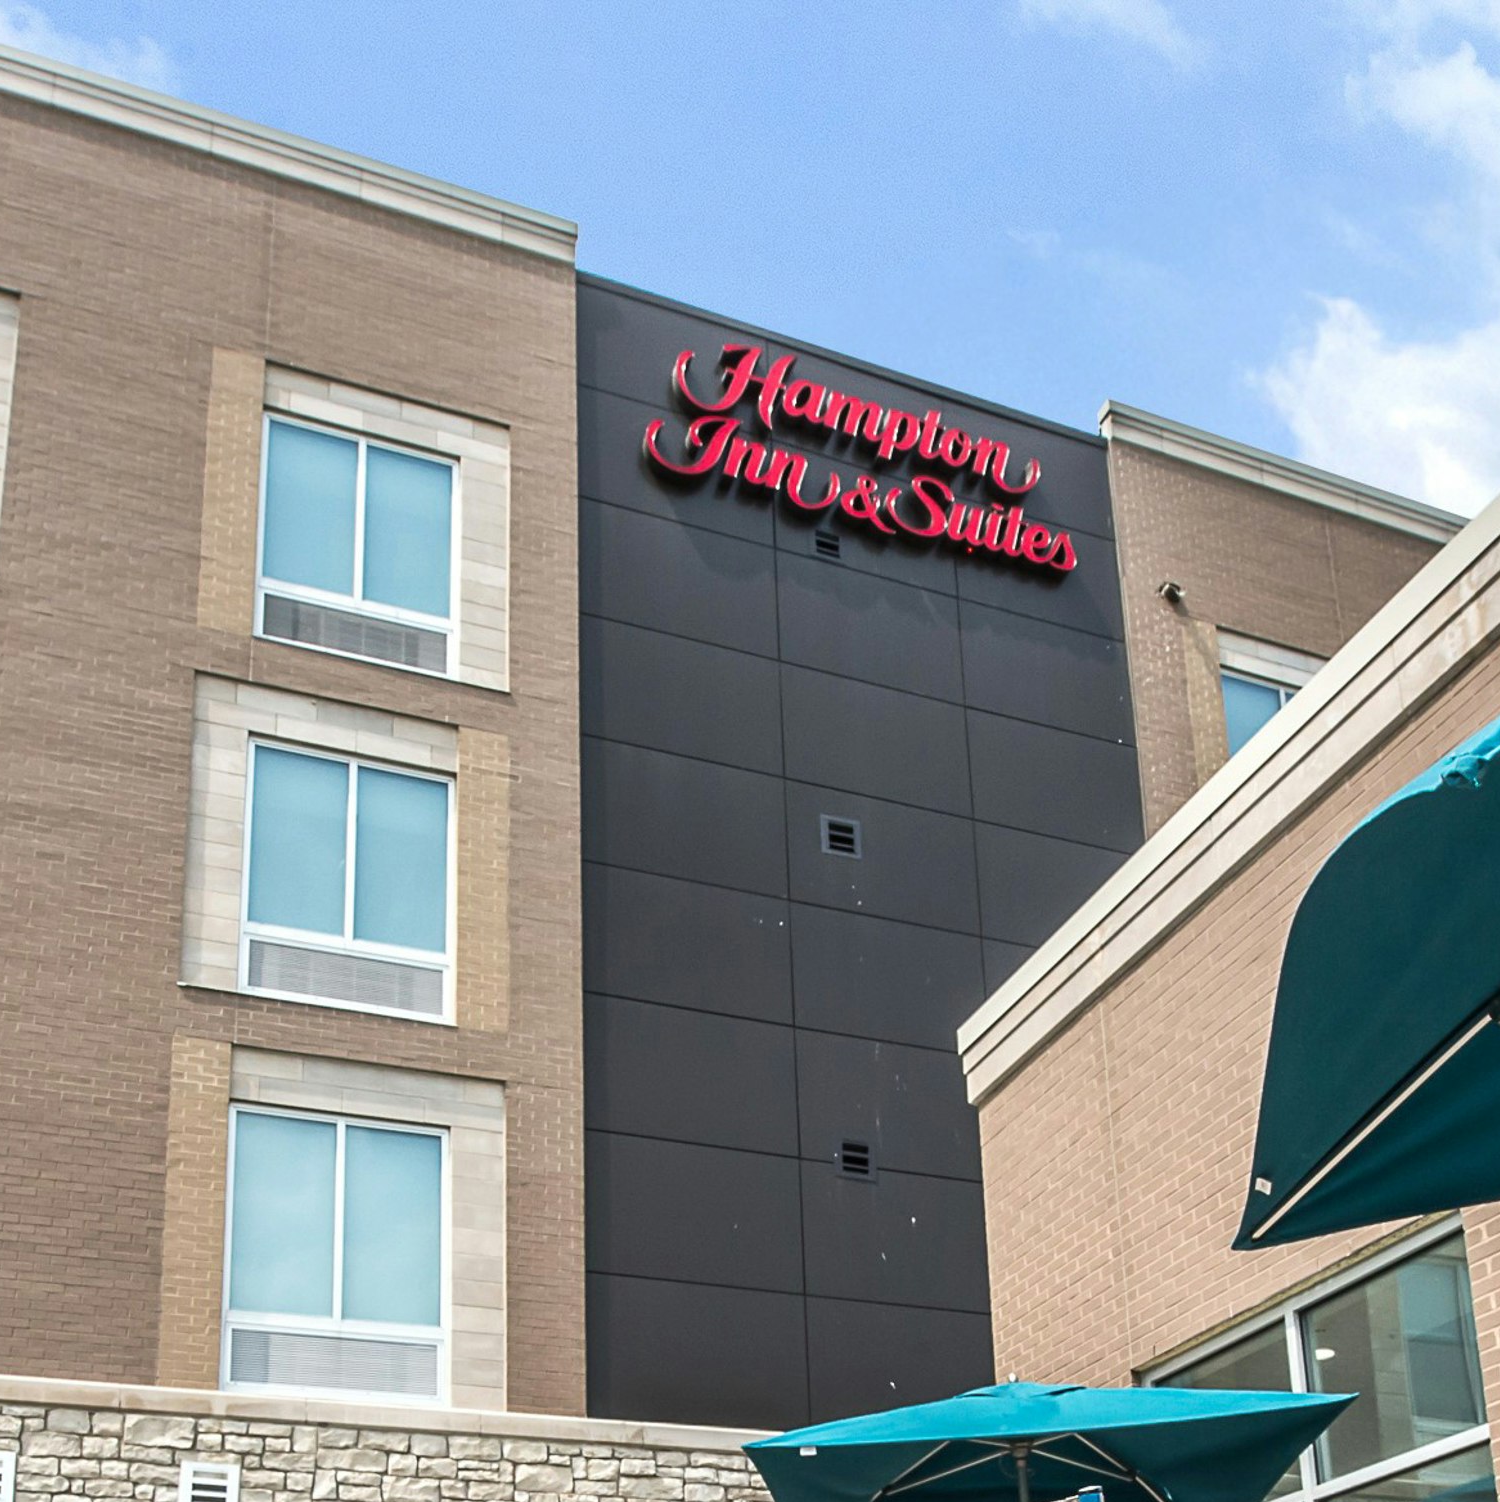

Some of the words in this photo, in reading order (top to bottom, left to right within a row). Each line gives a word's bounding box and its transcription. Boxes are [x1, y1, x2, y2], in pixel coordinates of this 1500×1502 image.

[642, 415, 841, 510] Inn
[840, 475, 896, 534] &
[884, 476, 1078, 572] Suites
[672, 343, 1041, 494] Hampton
